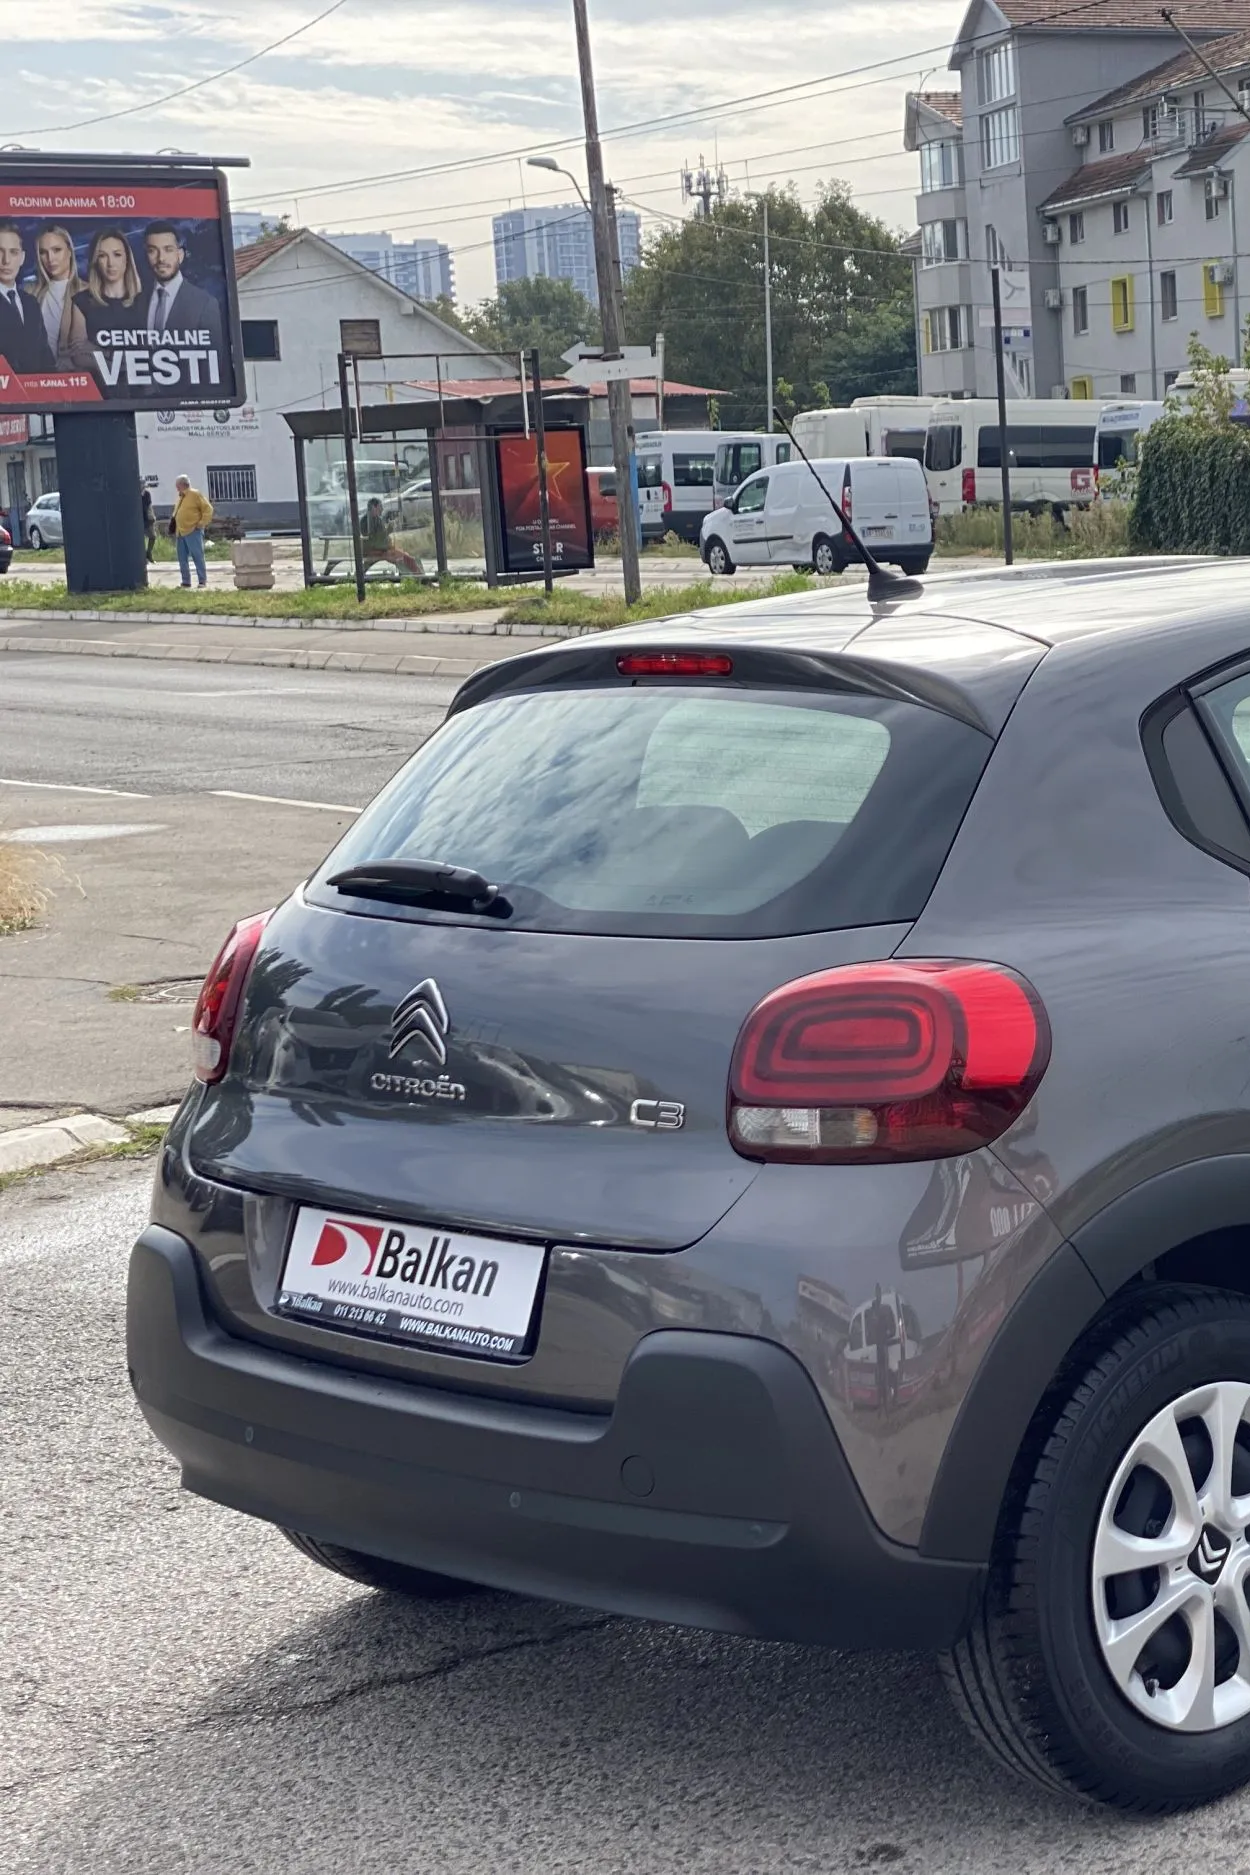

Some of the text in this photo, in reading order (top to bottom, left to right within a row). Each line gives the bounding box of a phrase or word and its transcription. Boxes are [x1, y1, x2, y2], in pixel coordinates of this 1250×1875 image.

[9, 195, 135, 208] RADNIM DANIMA 18:00
[96, 329, 211, 346] CENTRALNE
[40, 379, 67, 387] KANAL
[69, 376, 87, 386] 115
[93, 349, 220, 386] VESTI
[533, 542, 564, 554] STR
[371, 1073, 466, 1100] CITROËN
[630, 1098, 685, 1129] C3
[375, 1229, 500, 1297] Balkan
[327, 1277, 464, 1317] www.balkanauto.com
[334, 1303, 348, 1318] 011
[348, 1306, 364, 1320] 213
[374, 1312, 387, 1325] 42
[400, 1316, 514, 1351] WWW.BALKANAUTO.COM
